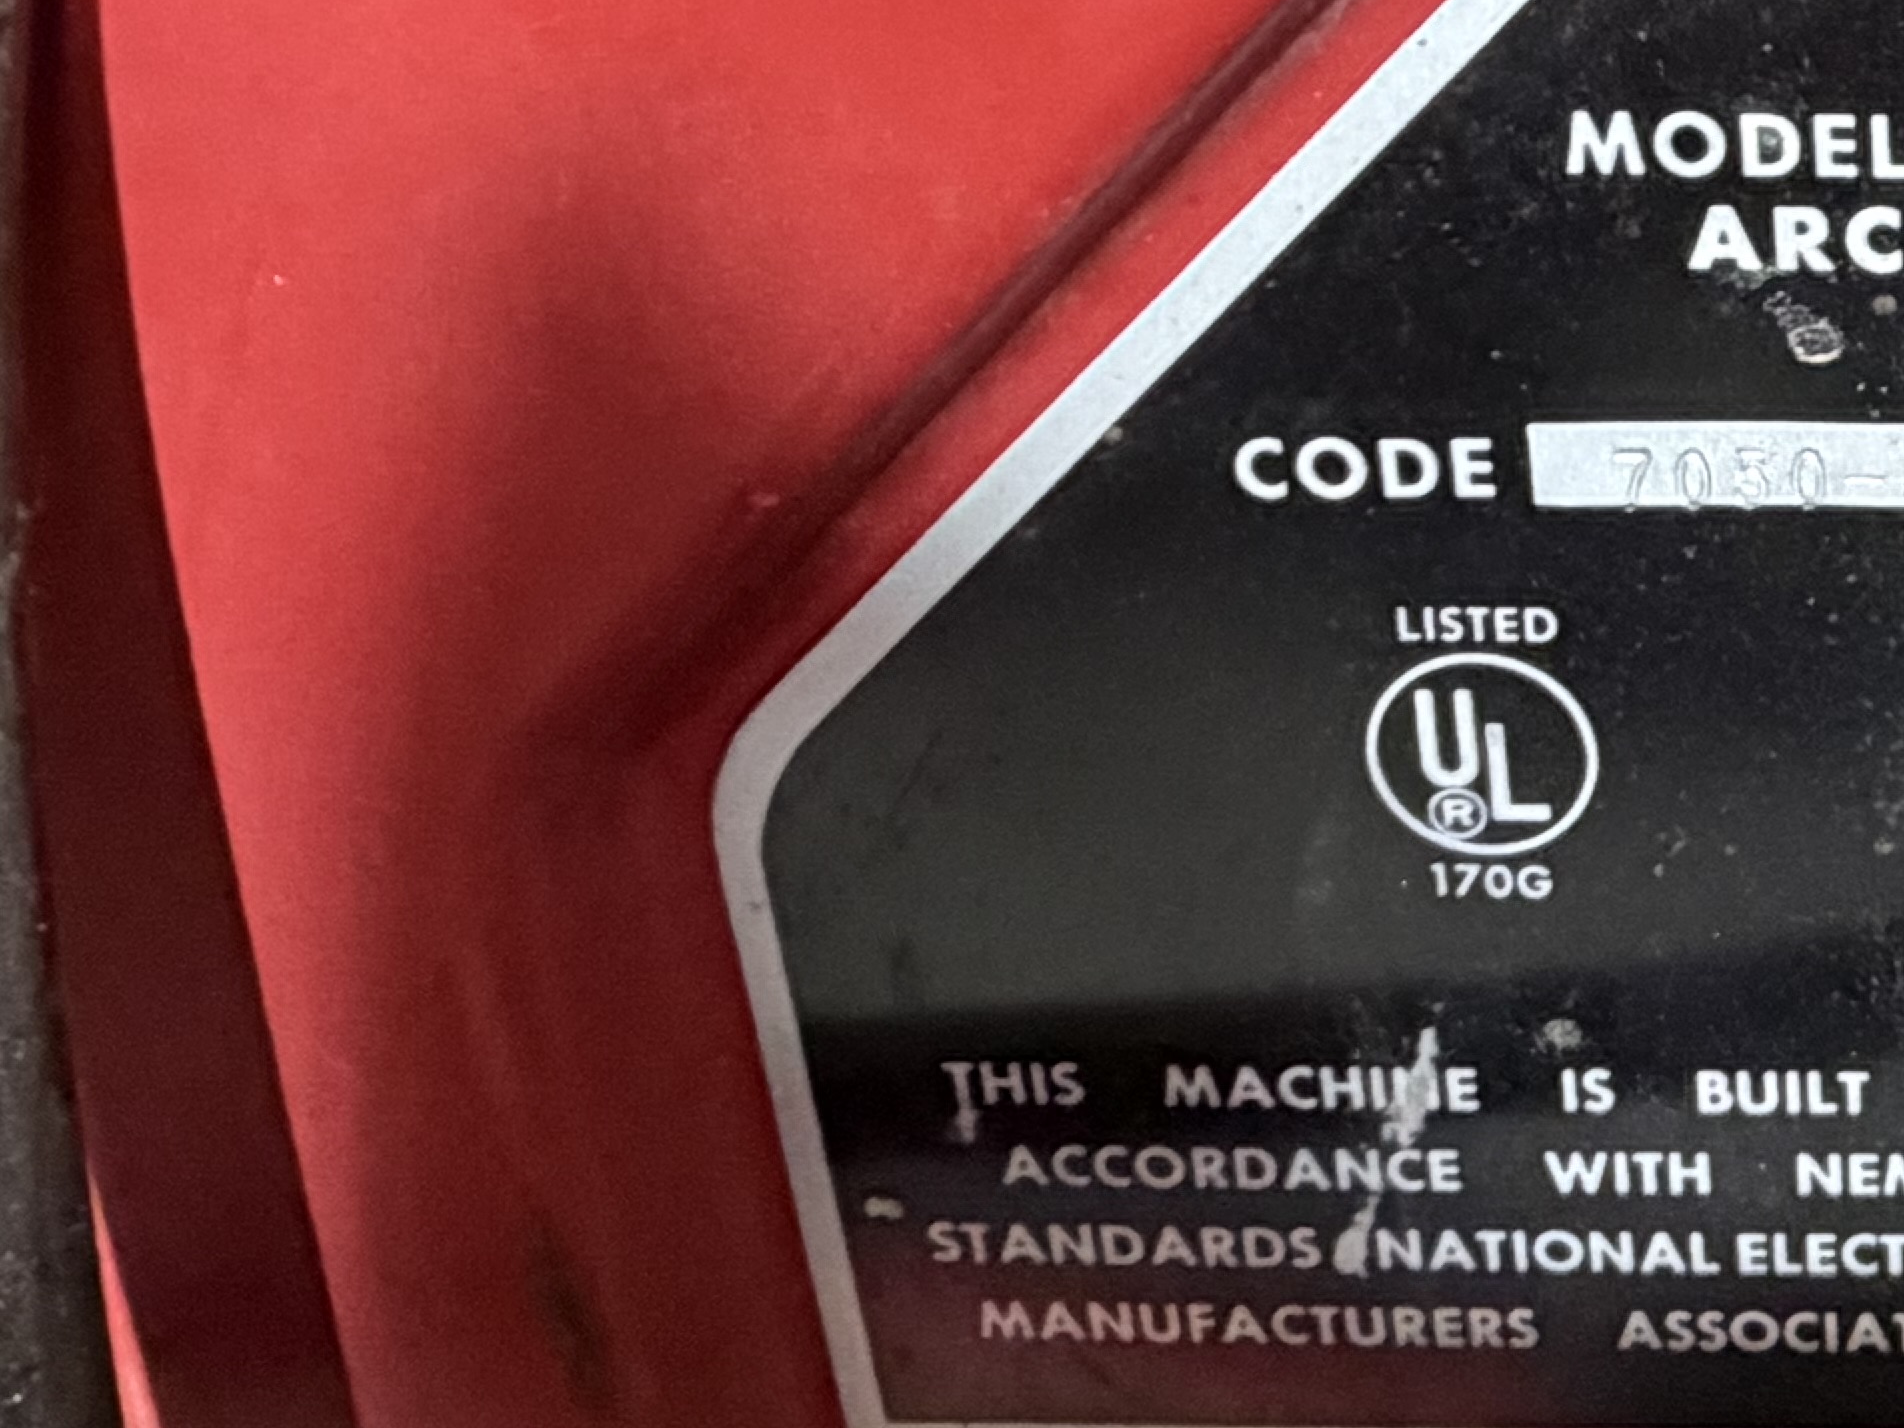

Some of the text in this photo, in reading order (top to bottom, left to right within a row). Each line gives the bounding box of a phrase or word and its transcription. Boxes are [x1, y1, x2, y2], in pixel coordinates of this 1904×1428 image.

[1688, 205, 1903, 276] ARC
[1235, 437, 1496, 500] CODE
[1397, 606, 1557, 643] LISTED
[1412, 687, 1552, 822] UL
[1431, 863, 1552, 899] 170G
[942, 1060, 1087, 1108] THIS
[1164, 1063, 1481, 1114] MACHINE
[1562, 1068, 1615, 1114] IS
[1696, 1070, 1869, 1115] BUILT
[1003, 1143, 1461, 1192] ACCORDANCE
[1545, 1151, 1711, 1195] WITH
[928, 1222, 1321, 1268] STANDARDS
[982, 1301, 1537, 1347] MANUFACTURERS
